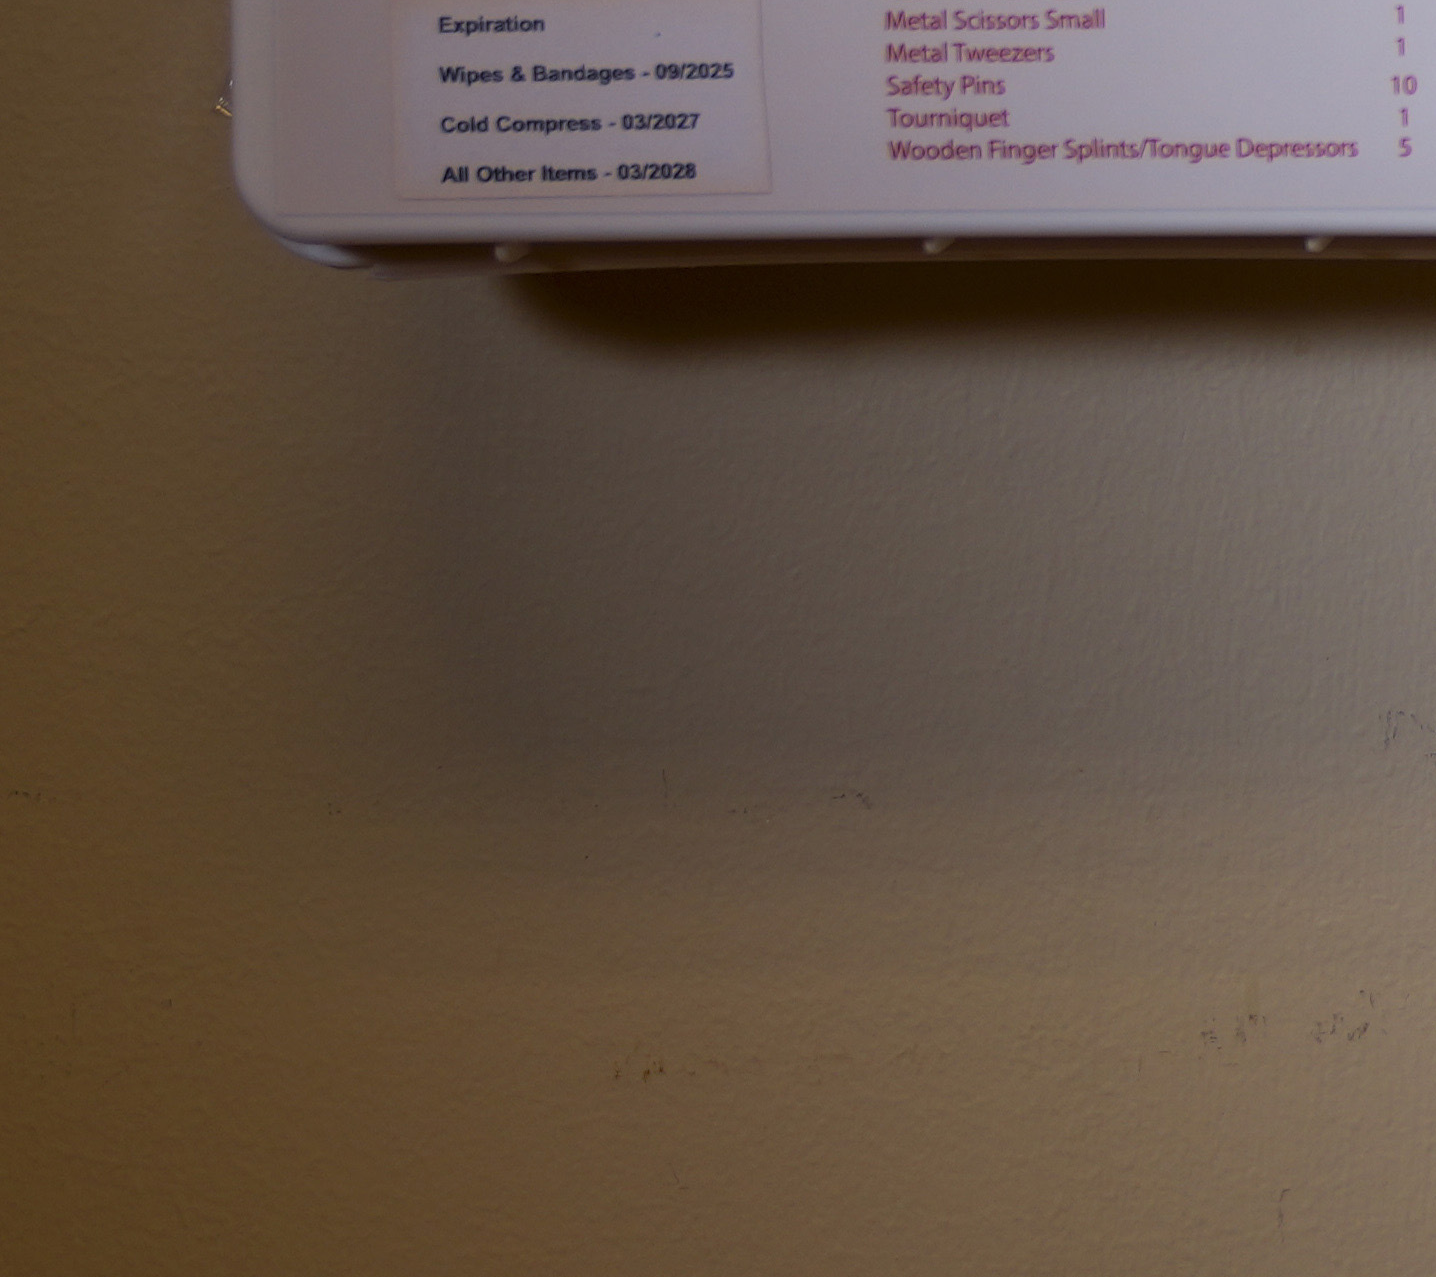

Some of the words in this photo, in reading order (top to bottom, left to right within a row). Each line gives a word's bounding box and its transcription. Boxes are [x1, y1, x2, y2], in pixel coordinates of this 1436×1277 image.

[437, 15, 545, 37] Expiration
[438, 66, 504, 87] Wipes
[510, 65, 527, 83] &
[531, 64, 636, 86] Bandages
[654, 62, 735, 81] 09/2025
[439, 115, 489, 134] Cold
[495, 115, 603, 136] Compress
[621, 112, 701, 131] 03/2027
